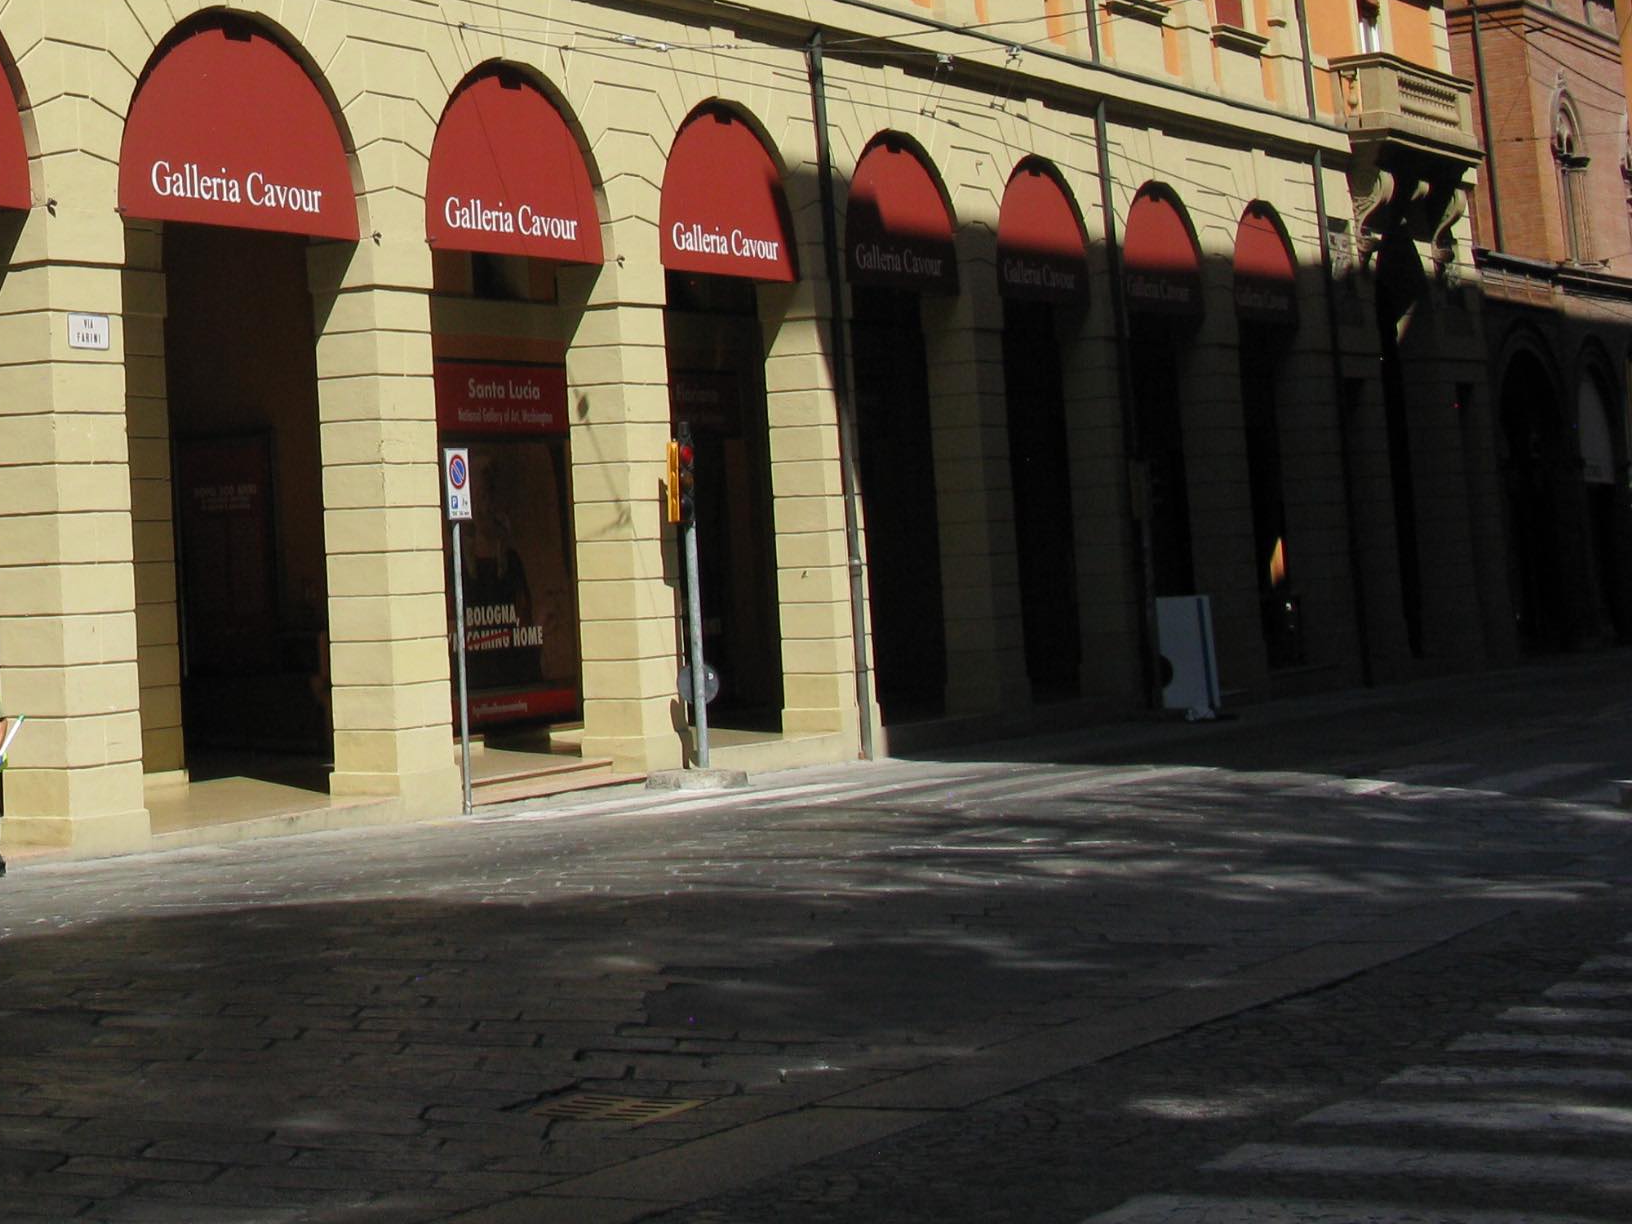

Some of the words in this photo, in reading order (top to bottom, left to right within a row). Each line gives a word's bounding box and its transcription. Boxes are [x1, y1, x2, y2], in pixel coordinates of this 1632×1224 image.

[151, 160, 242, 204] Galleria
[246, 172, 323, 213] Cavour
[444, 196, 515, 233] Galleria
[517, 205, 578, 241] Cavour
[672, 221, 729, 254] Galleria
[731, 229, 779, 261] Cavour
[855, 243, 902, 272] Galleria
[903, 248, 944, 277] Cavour
[83, 319, 95, 329] VIA
[76, 332, 102, 345] FARINI
[467, 377, 506, 399] Santa
[509, 378, 540, 401] Lucia
[466, 604, 520, 626] BOLOGNA,
[512, 626, 544, 647] HOME
